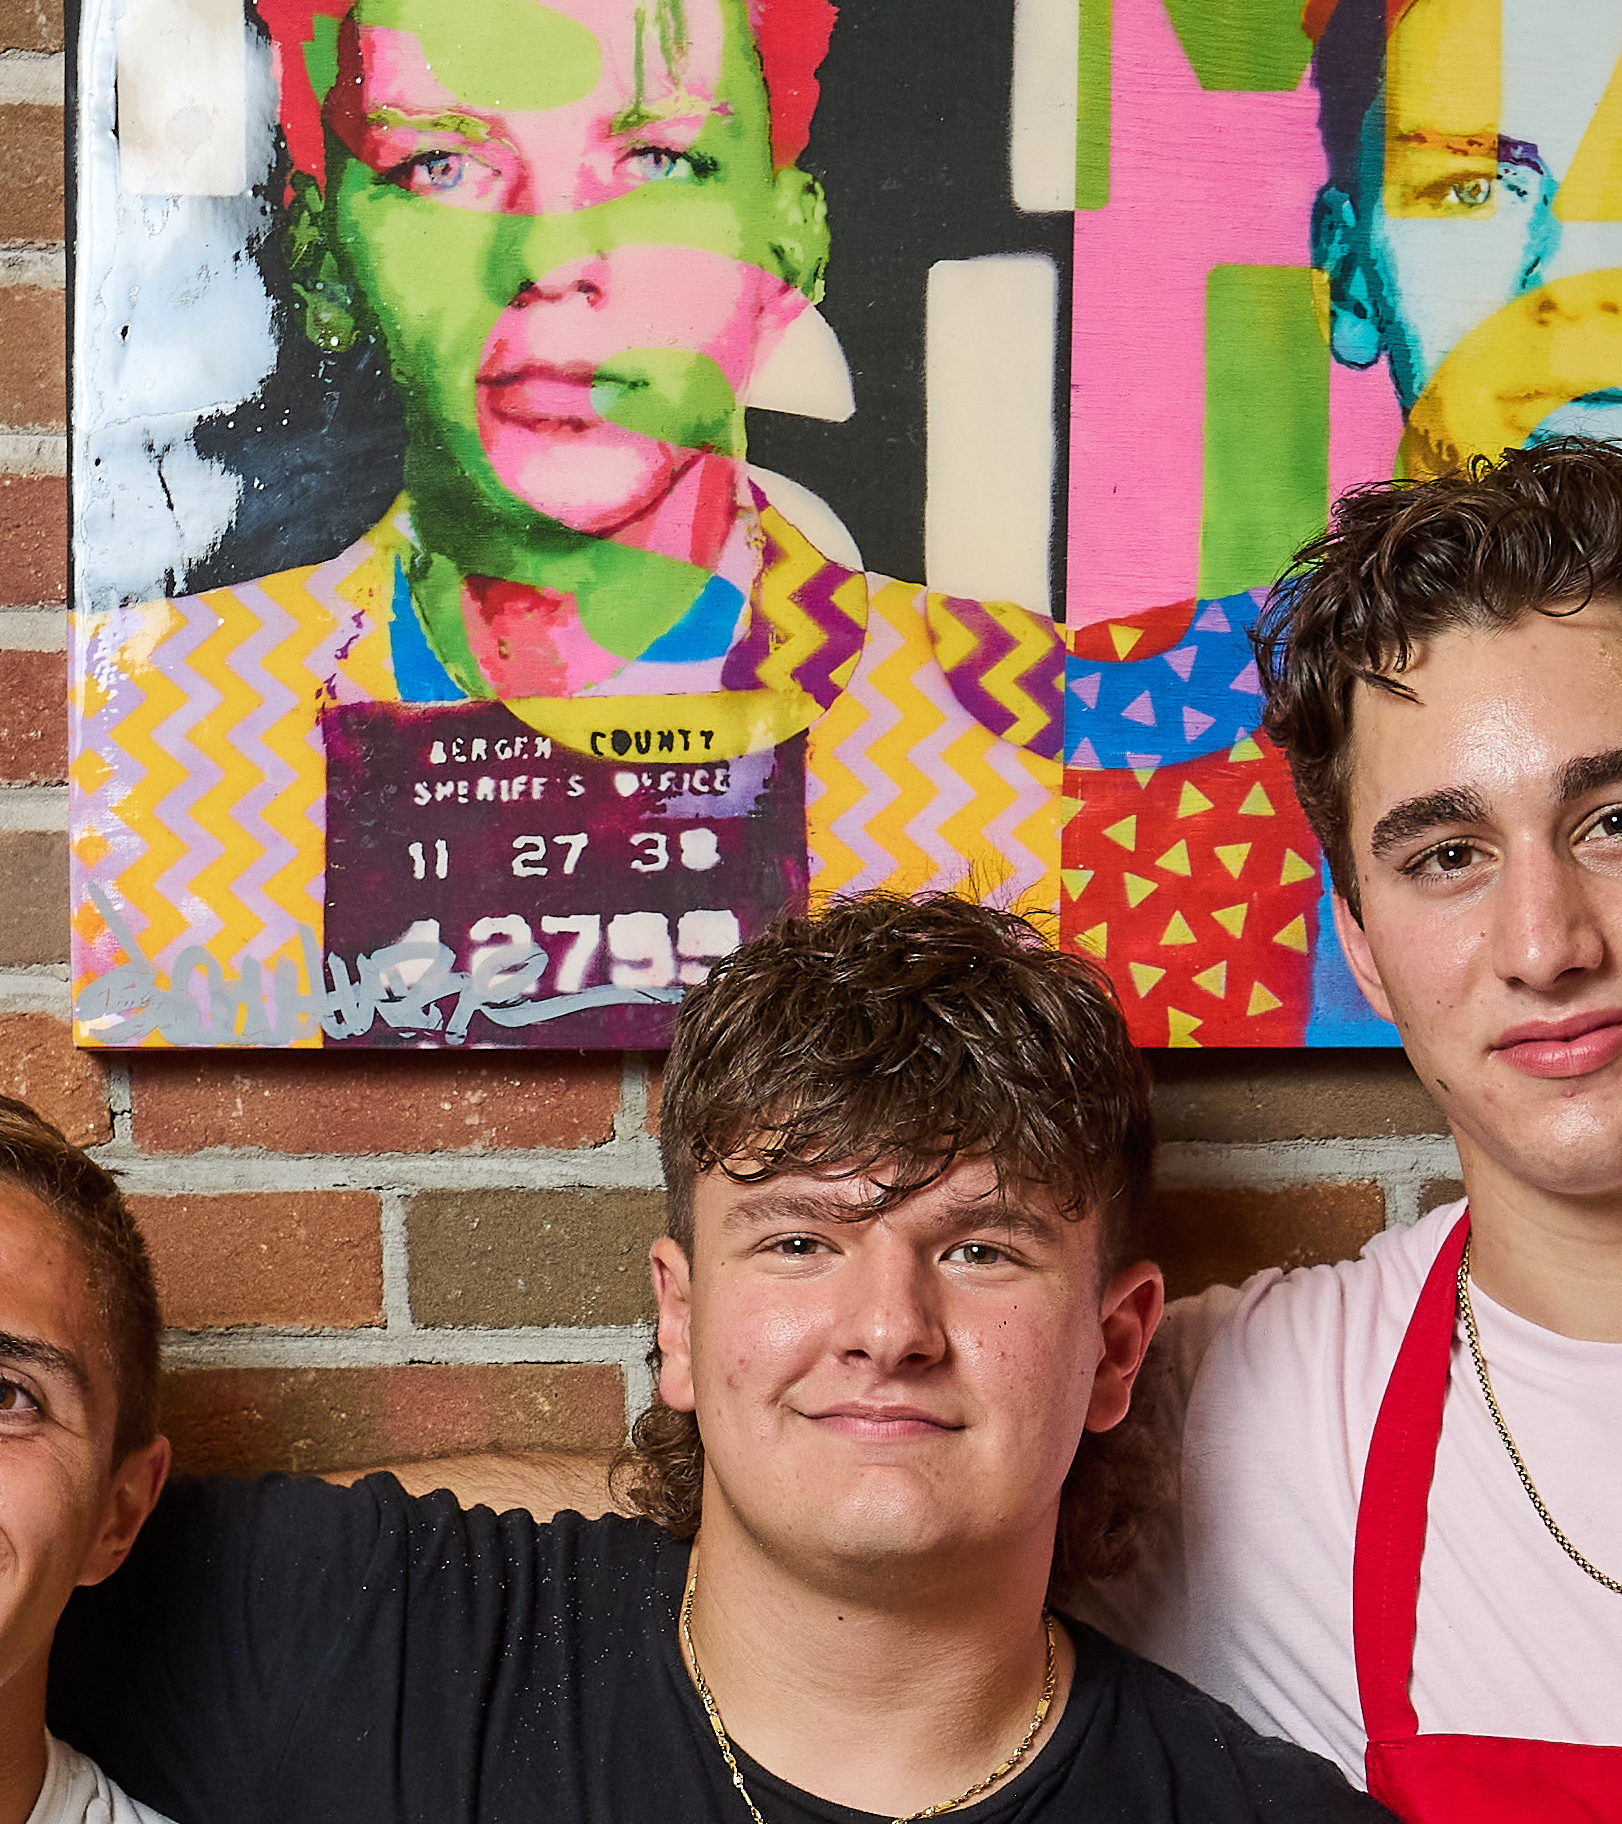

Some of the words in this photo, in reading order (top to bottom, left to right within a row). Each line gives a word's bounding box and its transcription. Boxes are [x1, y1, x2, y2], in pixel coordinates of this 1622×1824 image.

[589, 729, 716, 756] COUNTY
[407, 838, 449, 880] 11
[511, 832, 589, 878] 27
